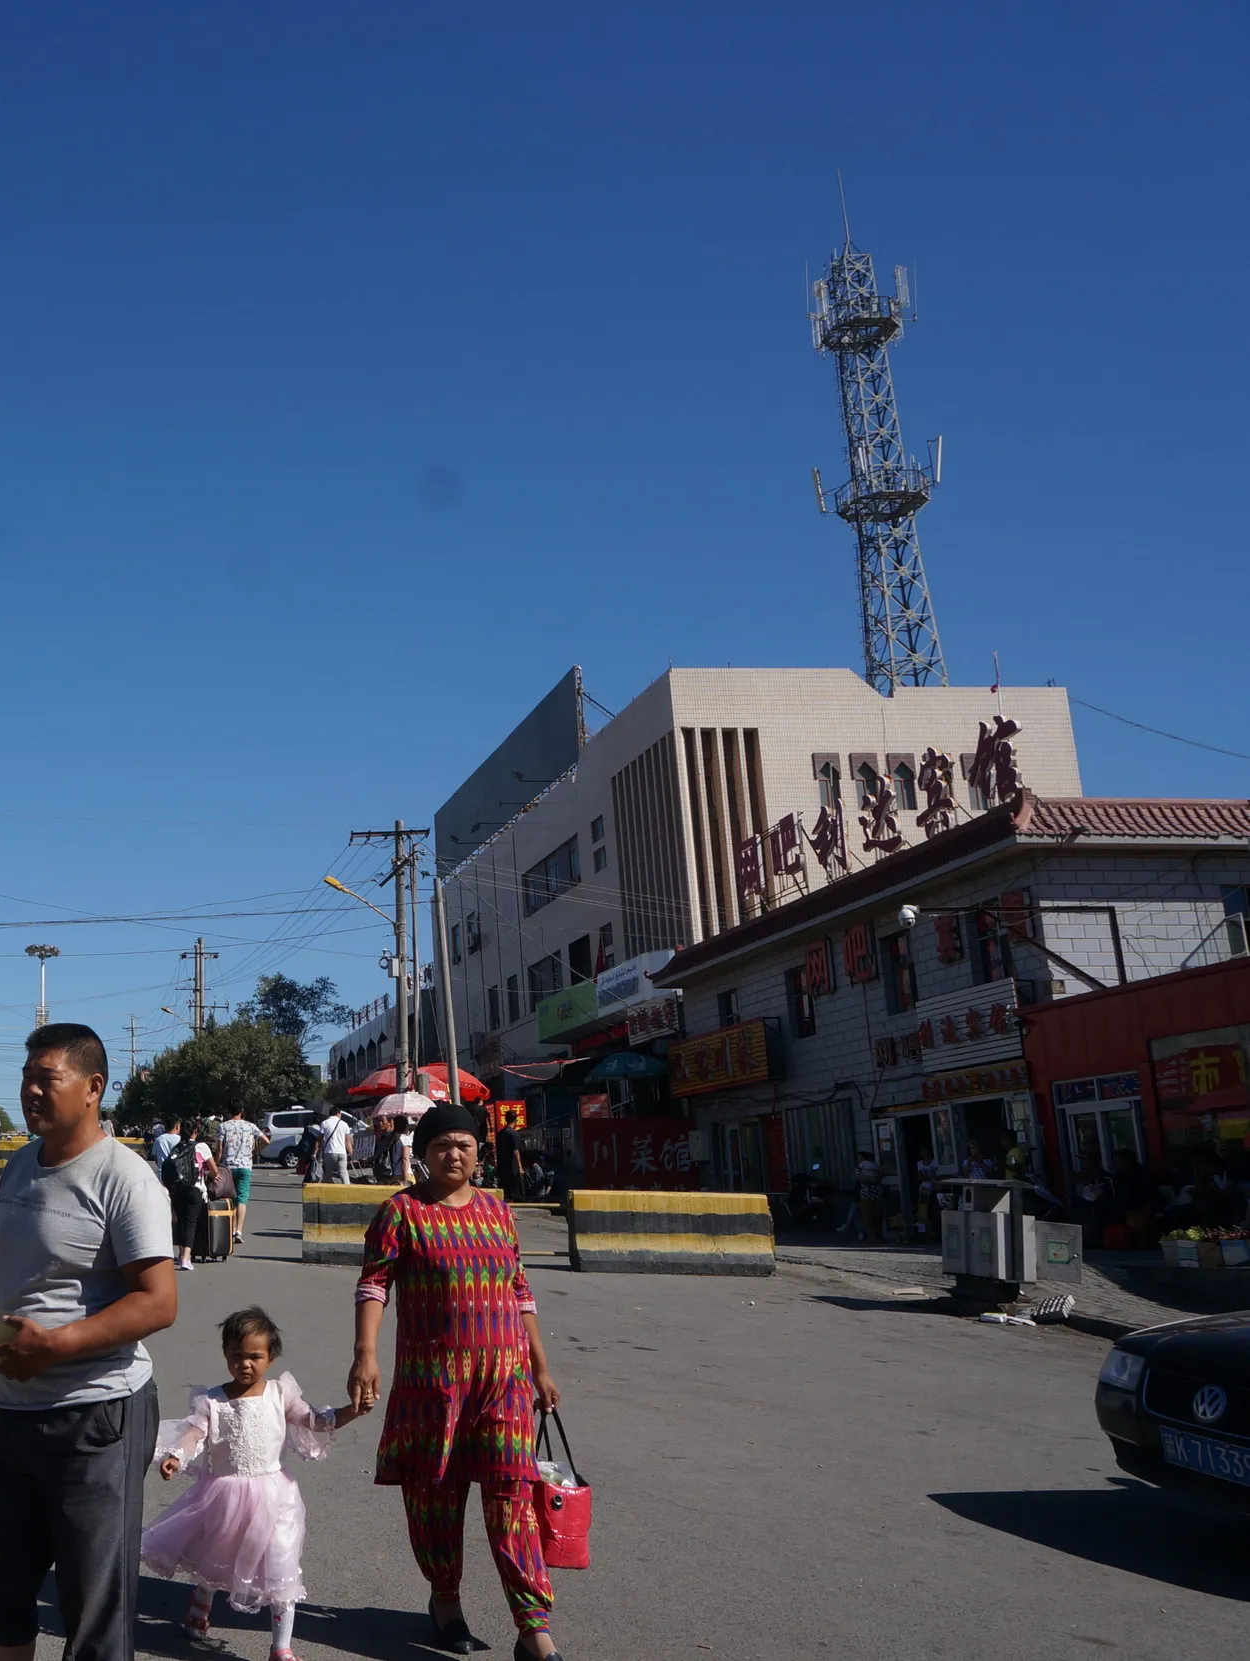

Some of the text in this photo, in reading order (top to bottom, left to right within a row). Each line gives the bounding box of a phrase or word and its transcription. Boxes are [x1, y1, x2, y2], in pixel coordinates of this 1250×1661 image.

[499, 1105, 524, 1115] 包子
[592, 1132, 692, 1175] 川菜馆
